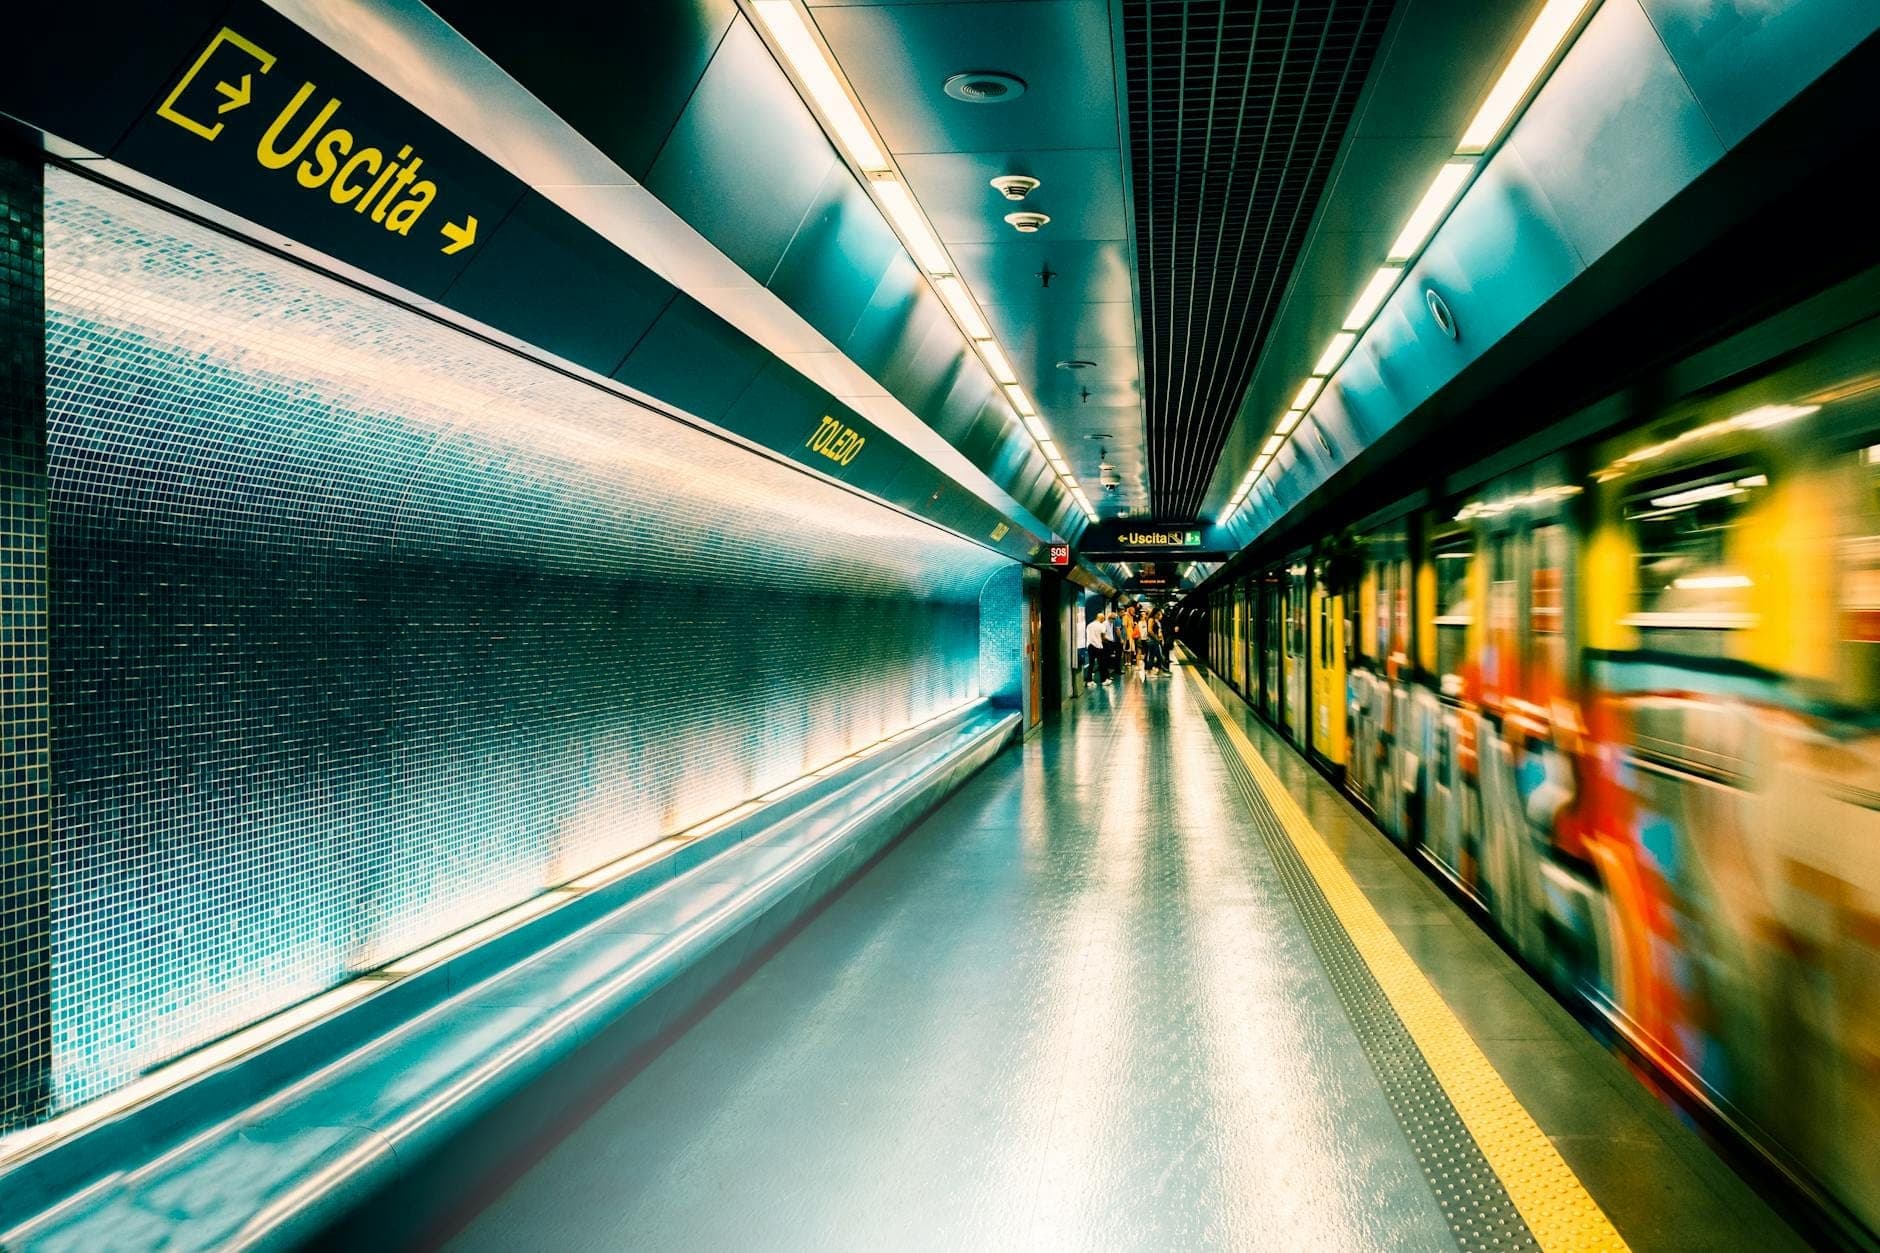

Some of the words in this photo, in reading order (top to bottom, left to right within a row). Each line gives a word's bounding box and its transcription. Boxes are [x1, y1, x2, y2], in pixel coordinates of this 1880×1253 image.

[257, 81, 437, 236] Uscita
[805, 415, 865, 466] TOLEDO
[1050, 548, 1067, 557] SOS
[1129, 532, 1167, 544] Uscita
